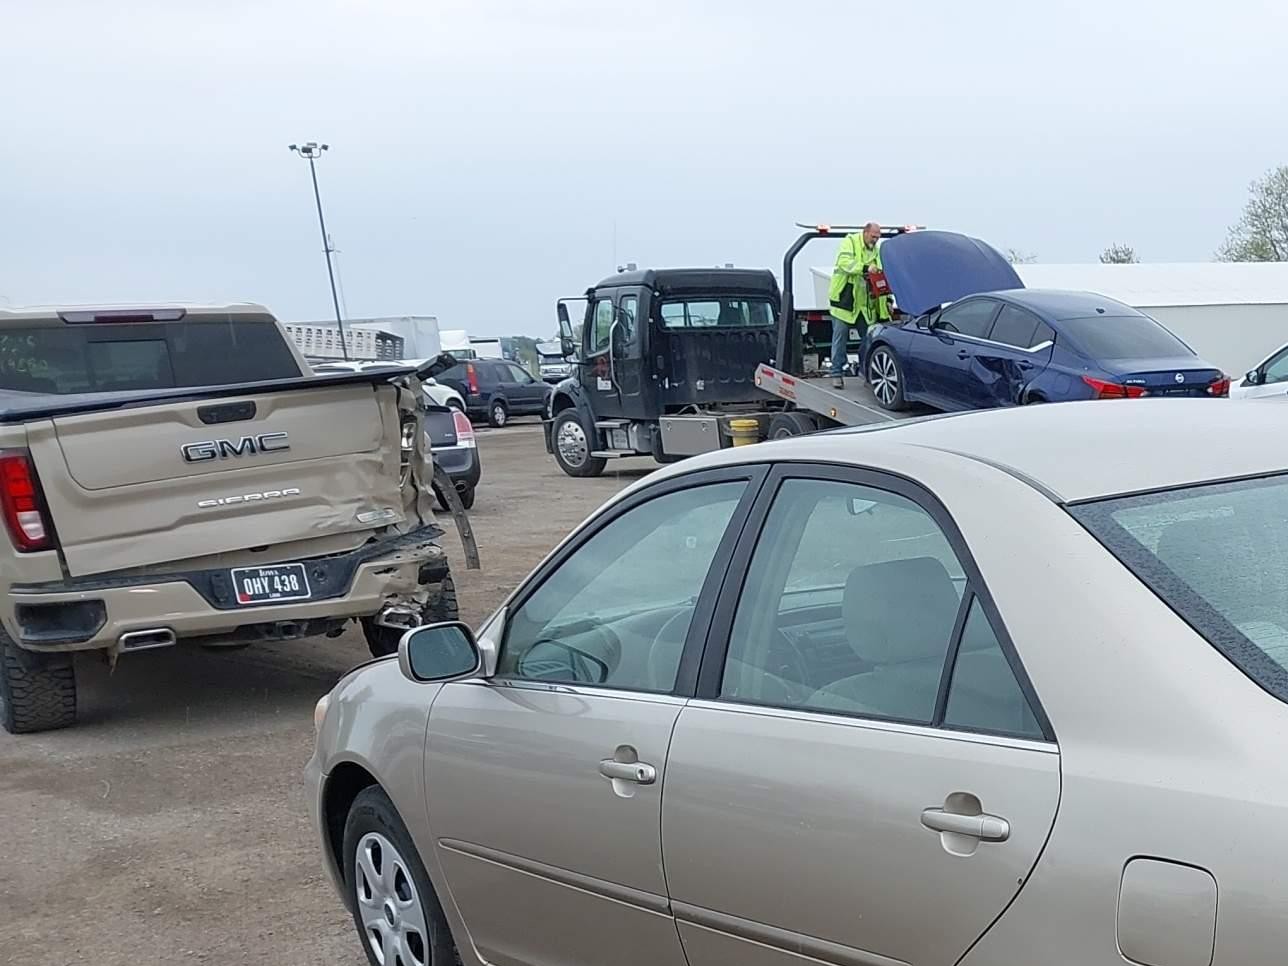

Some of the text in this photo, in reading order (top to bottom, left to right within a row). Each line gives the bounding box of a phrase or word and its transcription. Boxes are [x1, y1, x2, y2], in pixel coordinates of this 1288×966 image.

[181, 431, 290, 463] GMC
[197, 487, 301, 508] SIERRA
[273, 574, 299, 592] 438
